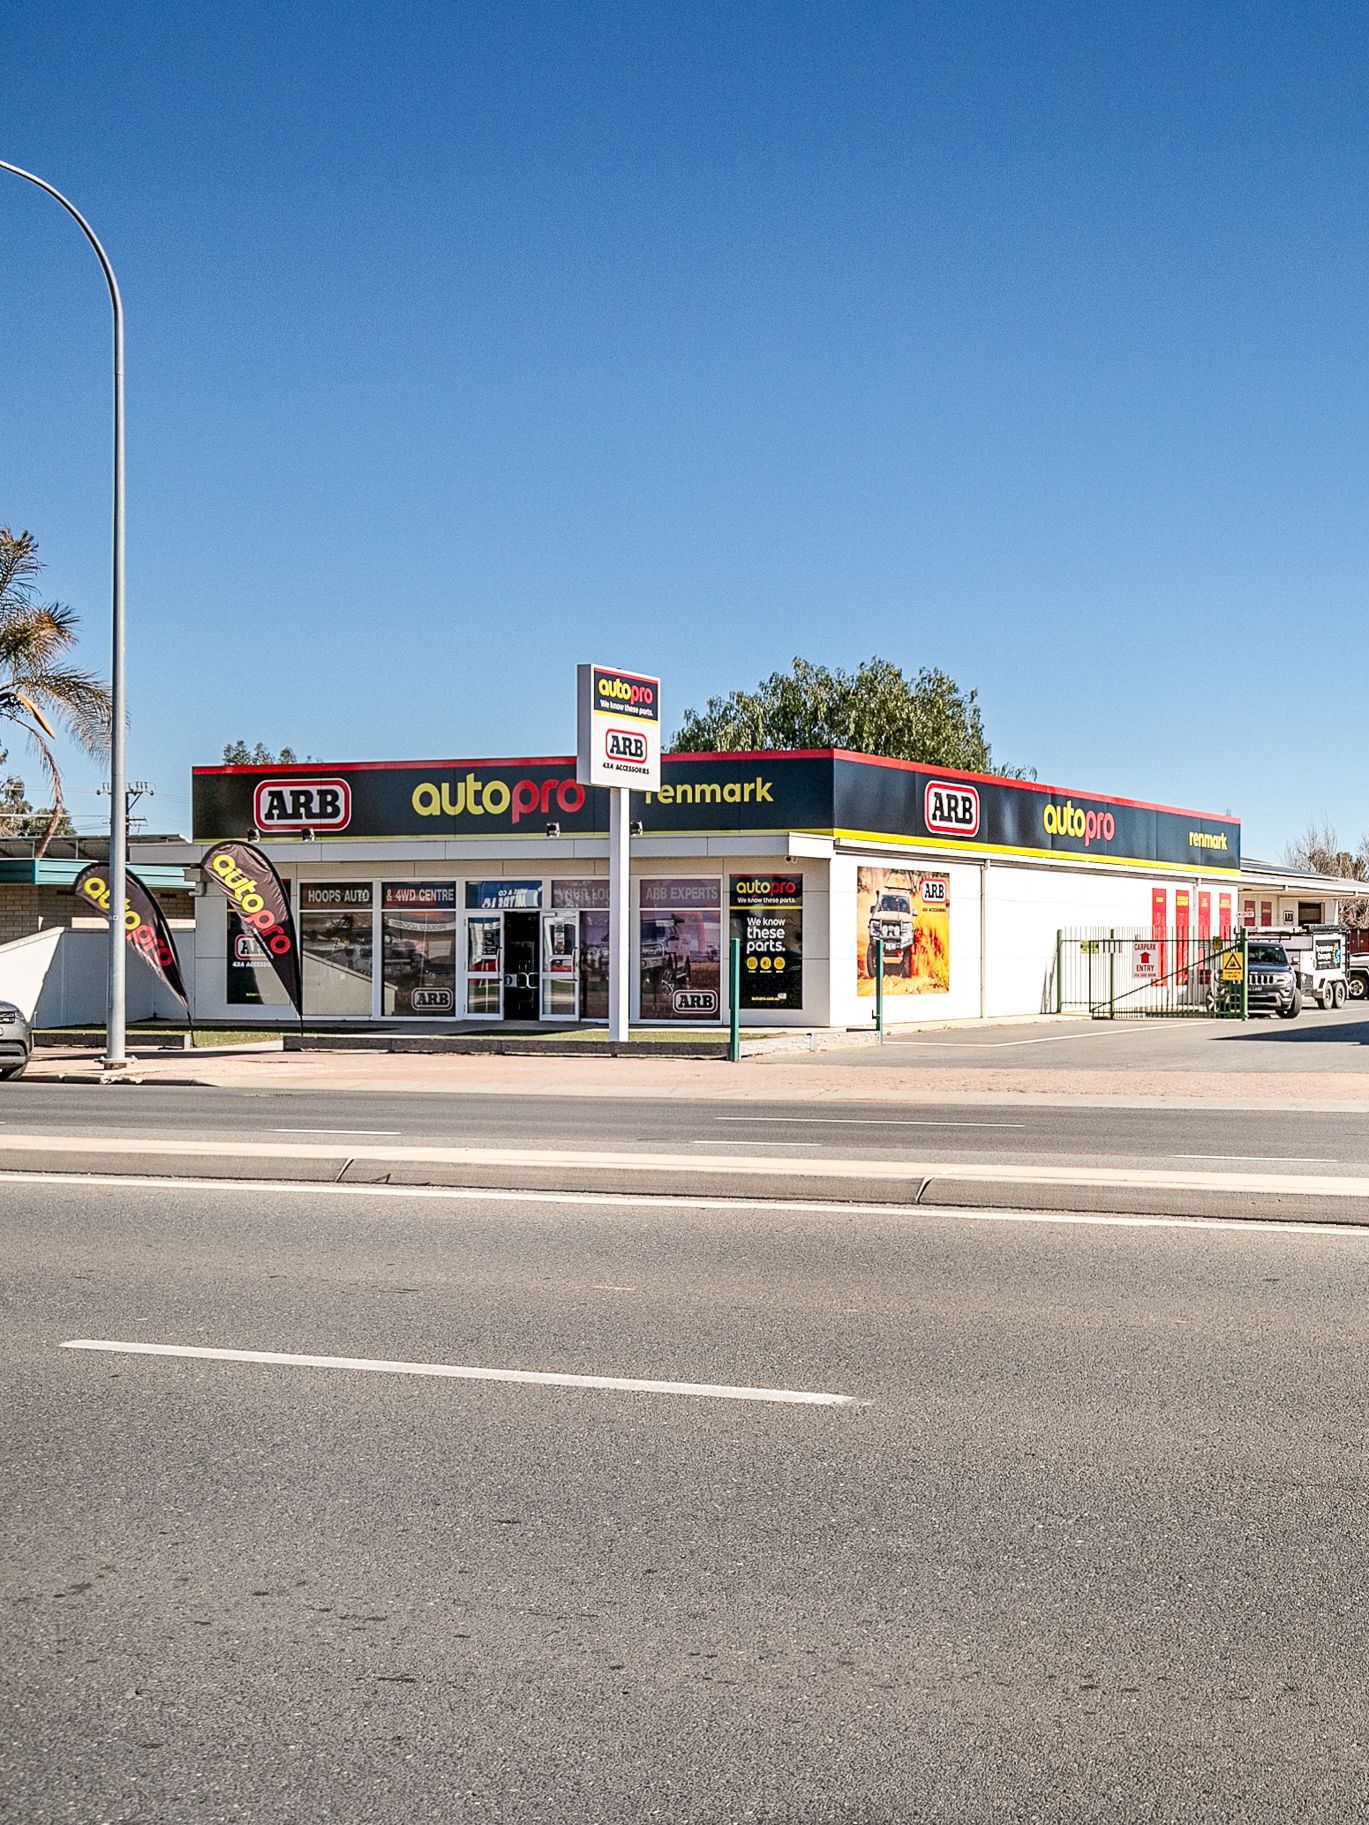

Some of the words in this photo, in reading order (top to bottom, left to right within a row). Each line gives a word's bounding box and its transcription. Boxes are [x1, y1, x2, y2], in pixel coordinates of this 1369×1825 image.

[598, 678, 653, 705] autopro
[600, 699, 609, 709] We
[610, 701, 624, 711] know
[625, 704, 639, 714] these
[609, 734, 643, 758] ARB
[615, 764, 650, 775] ACCESSORIES
[264, 788, 342, 821] ARB
[411, 772, 586, 825] autopro
[931, 791, 974, 825] ARB
[1043, 800, 1116, 847] autopro
[1188, 830, 1228, 851] renmark
[308, 889, 341, 902] HOOPS
[343, 889, 370, 902] AUTO
[386, 888, 392, 902] &
[395, 888, 416, 901] 4WD
[418, 888, 455, 901] CENTRE
[645, 887, 667, 900] ARB
[670, 886, 718, 900] EXPERTS
[736, 879, 796, 897] autopro
[924, 882, 945, 899] ARB
[212, 853, 292, 955] autopro
[747, 917, 761, 926] We
[762, 917, 786, 926] know
[746, 926, 785, 939] these
[746, 940, 786, 954] parts.
[1133, 943, 1156, 951] CARPARK
[1136, 964, 1155, 972] ENTRY
[416, 992, 450, 1006] ARB
[678, 994, 713, 1009] ARB
